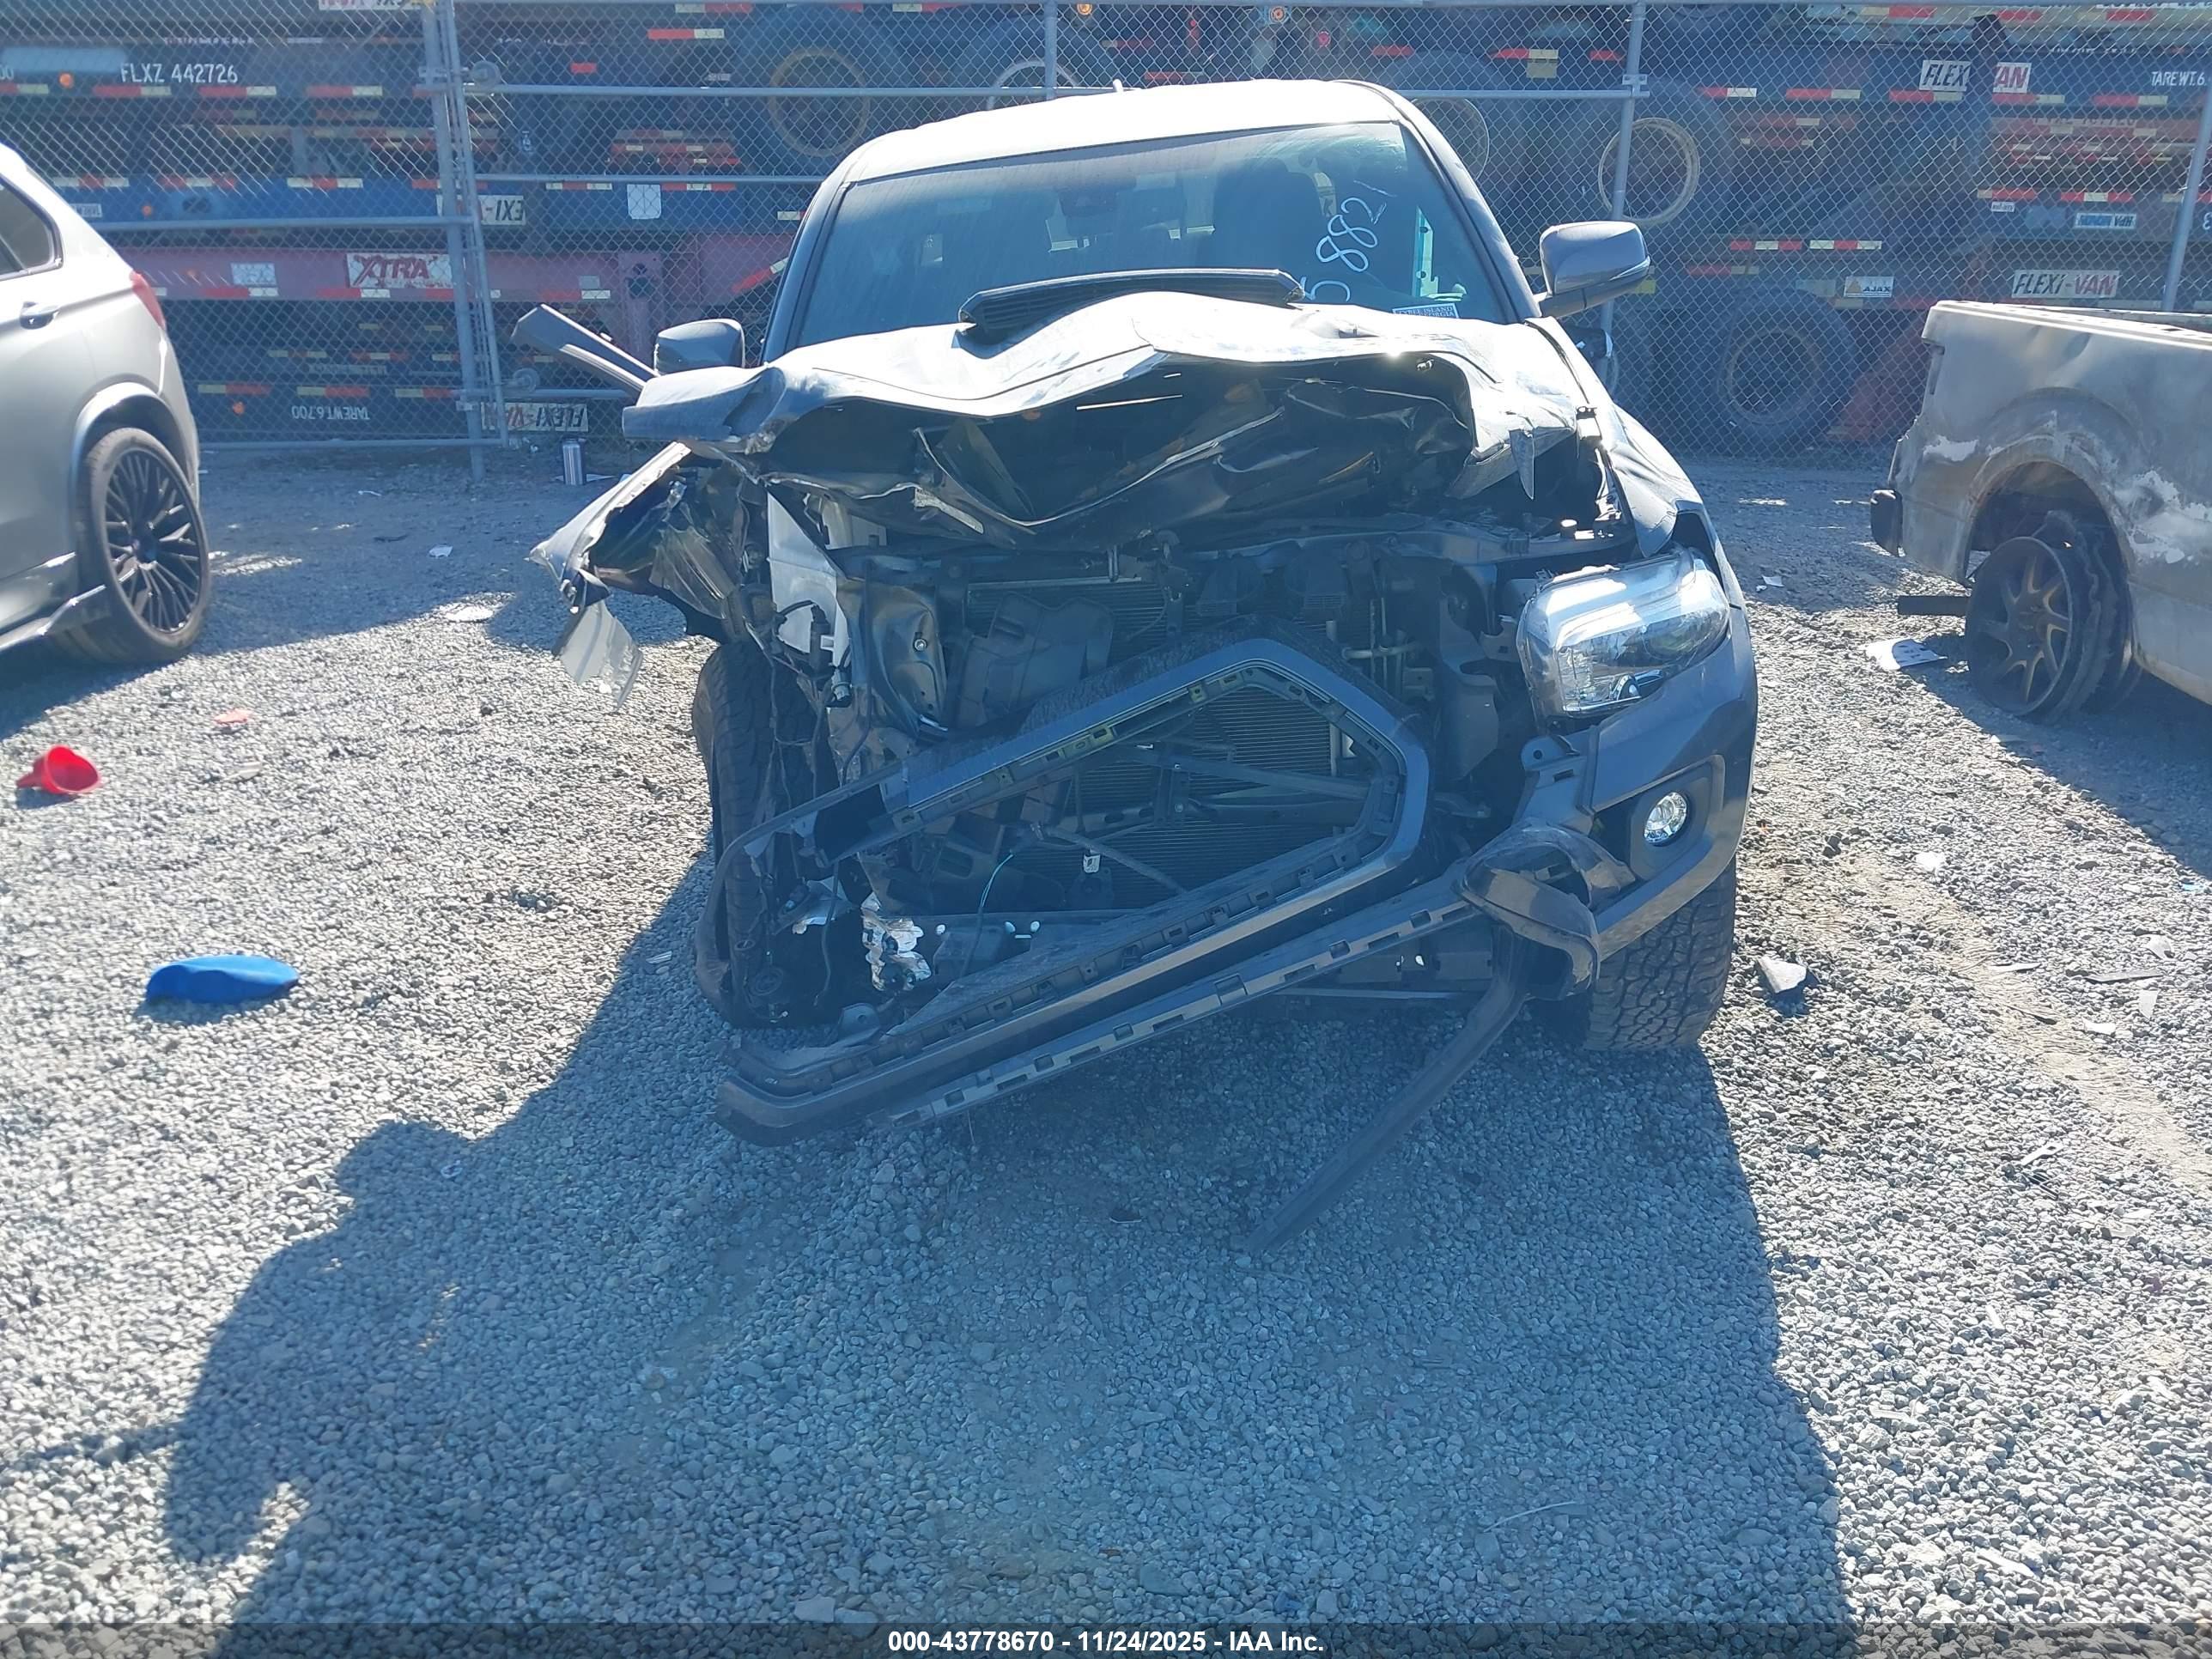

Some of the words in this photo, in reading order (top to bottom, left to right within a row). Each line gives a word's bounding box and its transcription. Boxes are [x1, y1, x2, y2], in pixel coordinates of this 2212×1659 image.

[120, 64, 164, 83] FLXZ
[171, 64, 238, 83] 442726
[353, 255, 429, 286] XTRA
[2014, 273, 2116, 295] FLEXI-VAN
